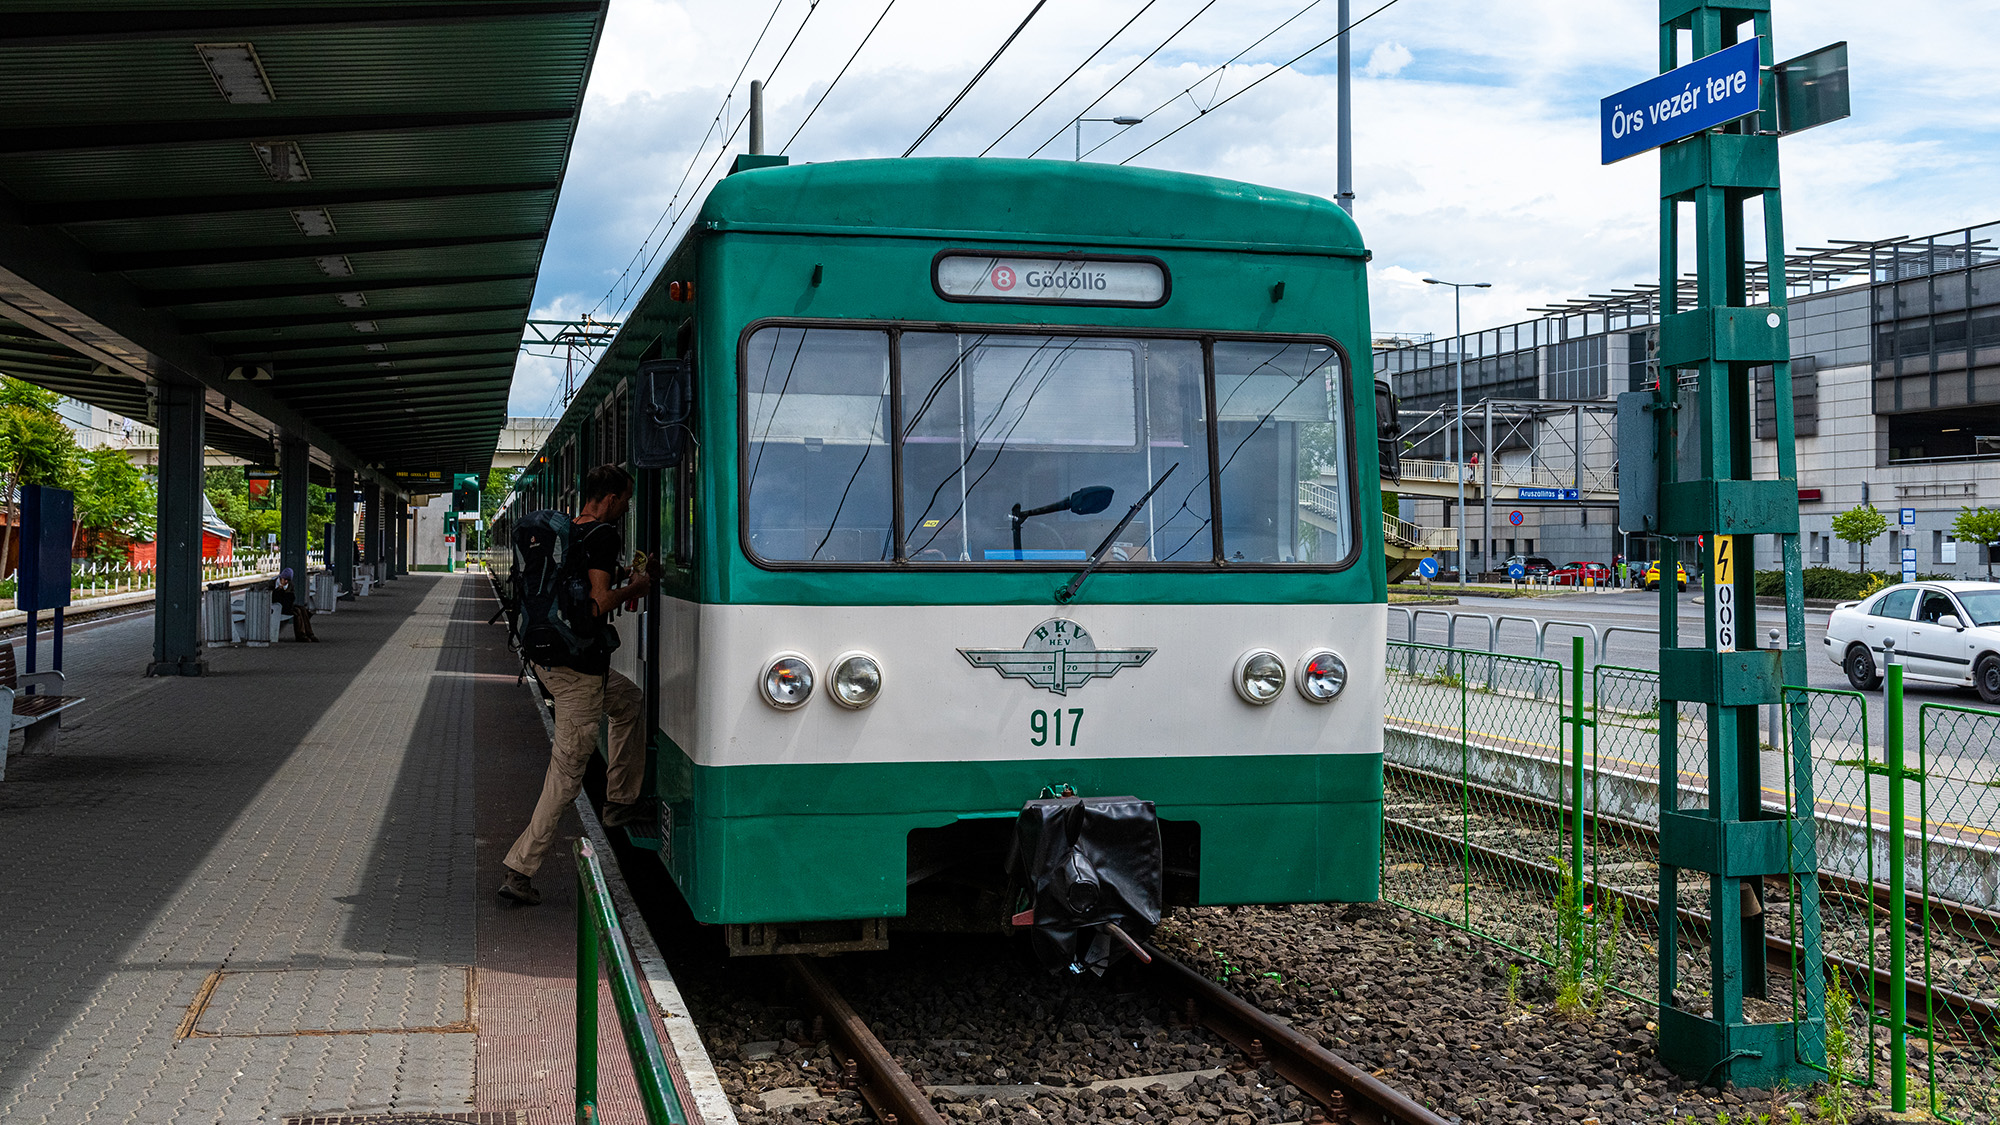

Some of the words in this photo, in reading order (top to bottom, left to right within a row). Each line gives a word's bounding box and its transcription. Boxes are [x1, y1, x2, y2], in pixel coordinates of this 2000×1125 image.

[1611, 104, 1644, 139] Örs
[1649, 82, 1700, 125] vezér
[1705, 69, 1747, 104] tere
[996, 270, 1011, 287] 8
[1025, 270, 1107, 291] Gödöllő
[1034, 620, 1087, 641] BKV
[1719, 586, 1732, 646] 006
[1049, 638, 1071, 646] HÉV
[1030, 707, 1084, 747] 917
